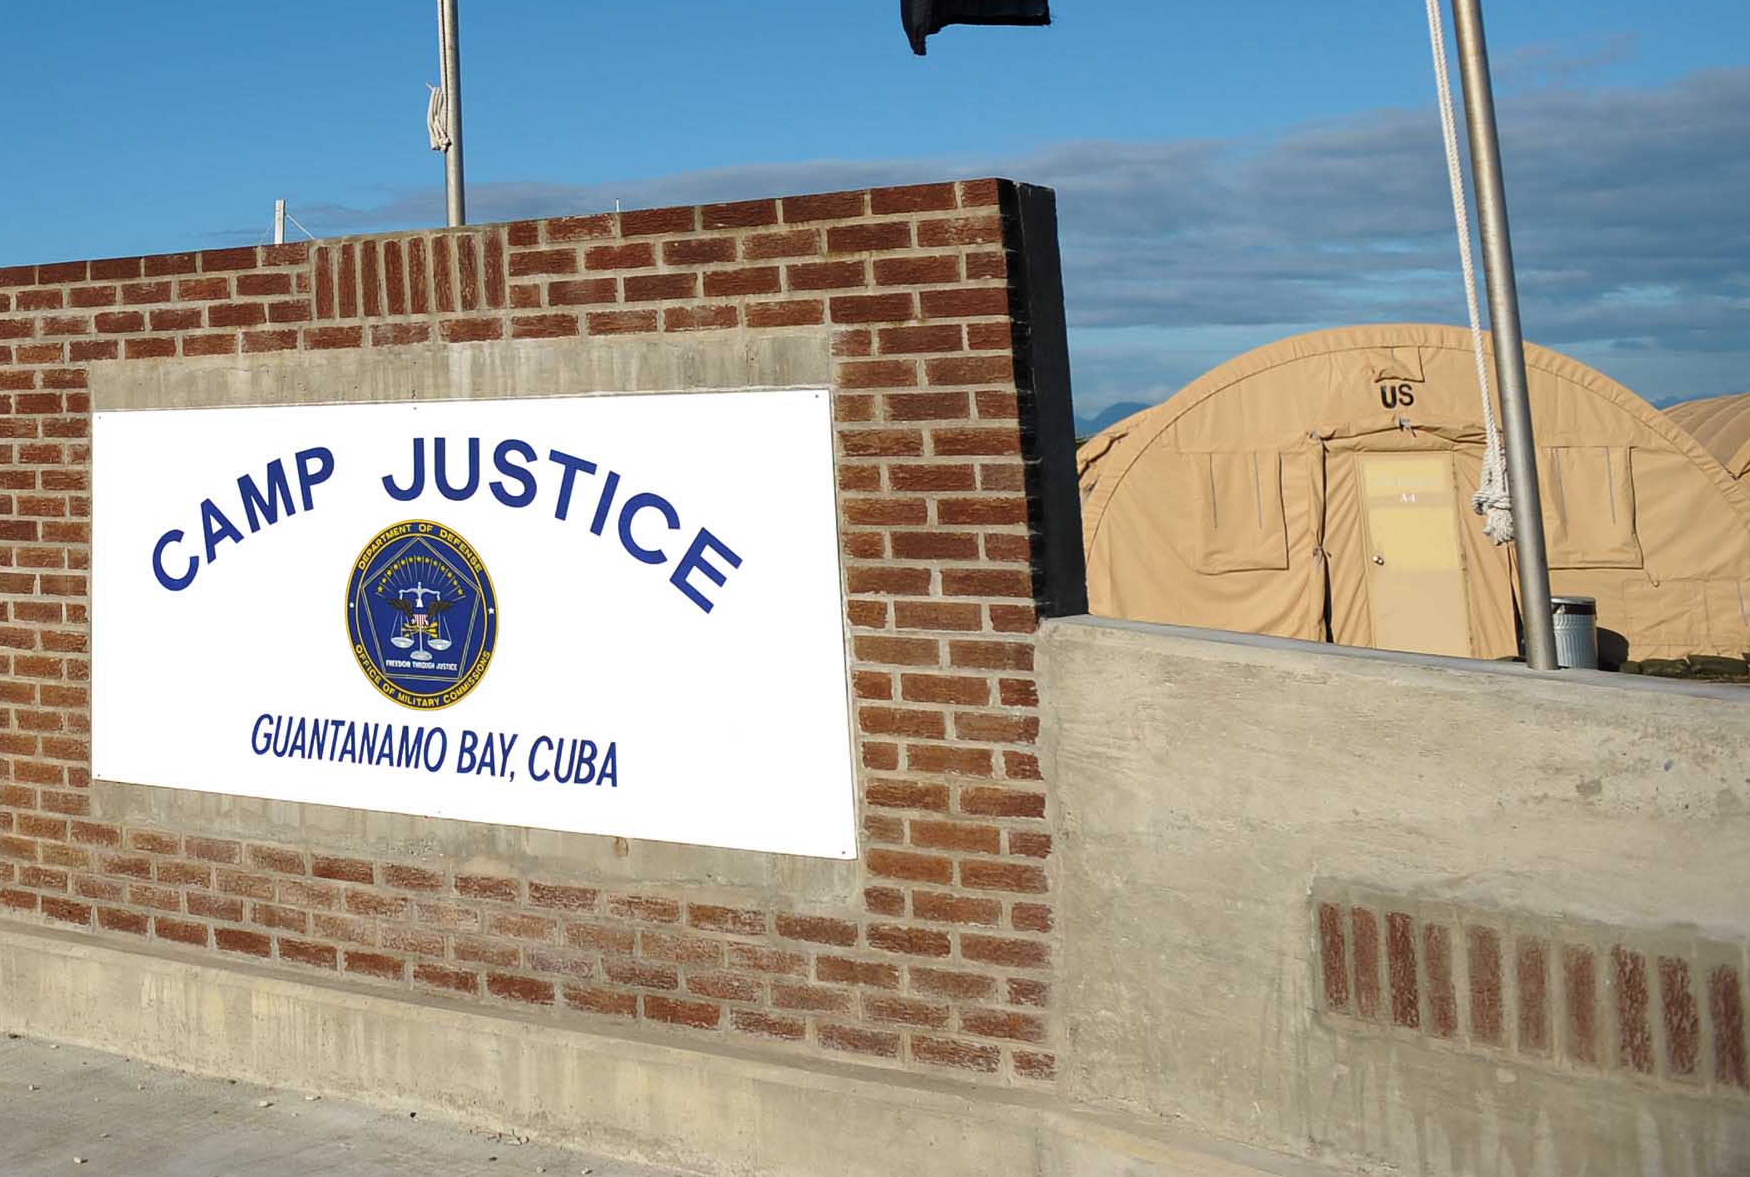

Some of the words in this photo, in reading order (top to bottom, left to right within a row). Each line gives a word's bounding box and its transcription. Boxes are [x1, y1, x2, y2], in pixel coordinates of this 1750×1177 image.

[1380, 383, 1414, 409] US
[152, 446, 335, 592] CAMP
[381, 436, 743, 615] JUSTICE
[357, 523, 412, 571] DEPARTMENT
[418, 523, 433, 533] OF
[439, 528, 482, 574] DEFENSE
[355, 644, 382, 684] OFFICE
[382, 682, 396, 695] OF
[397, 691, 440, 707] MILITARY
[442, 649, 491, 704] COMMISSIONS
[251, 713, 448, 773] GUANTANAMO
[456, 729, 519, 784] BAY,
[528, 735, 618, 788] CUBA
